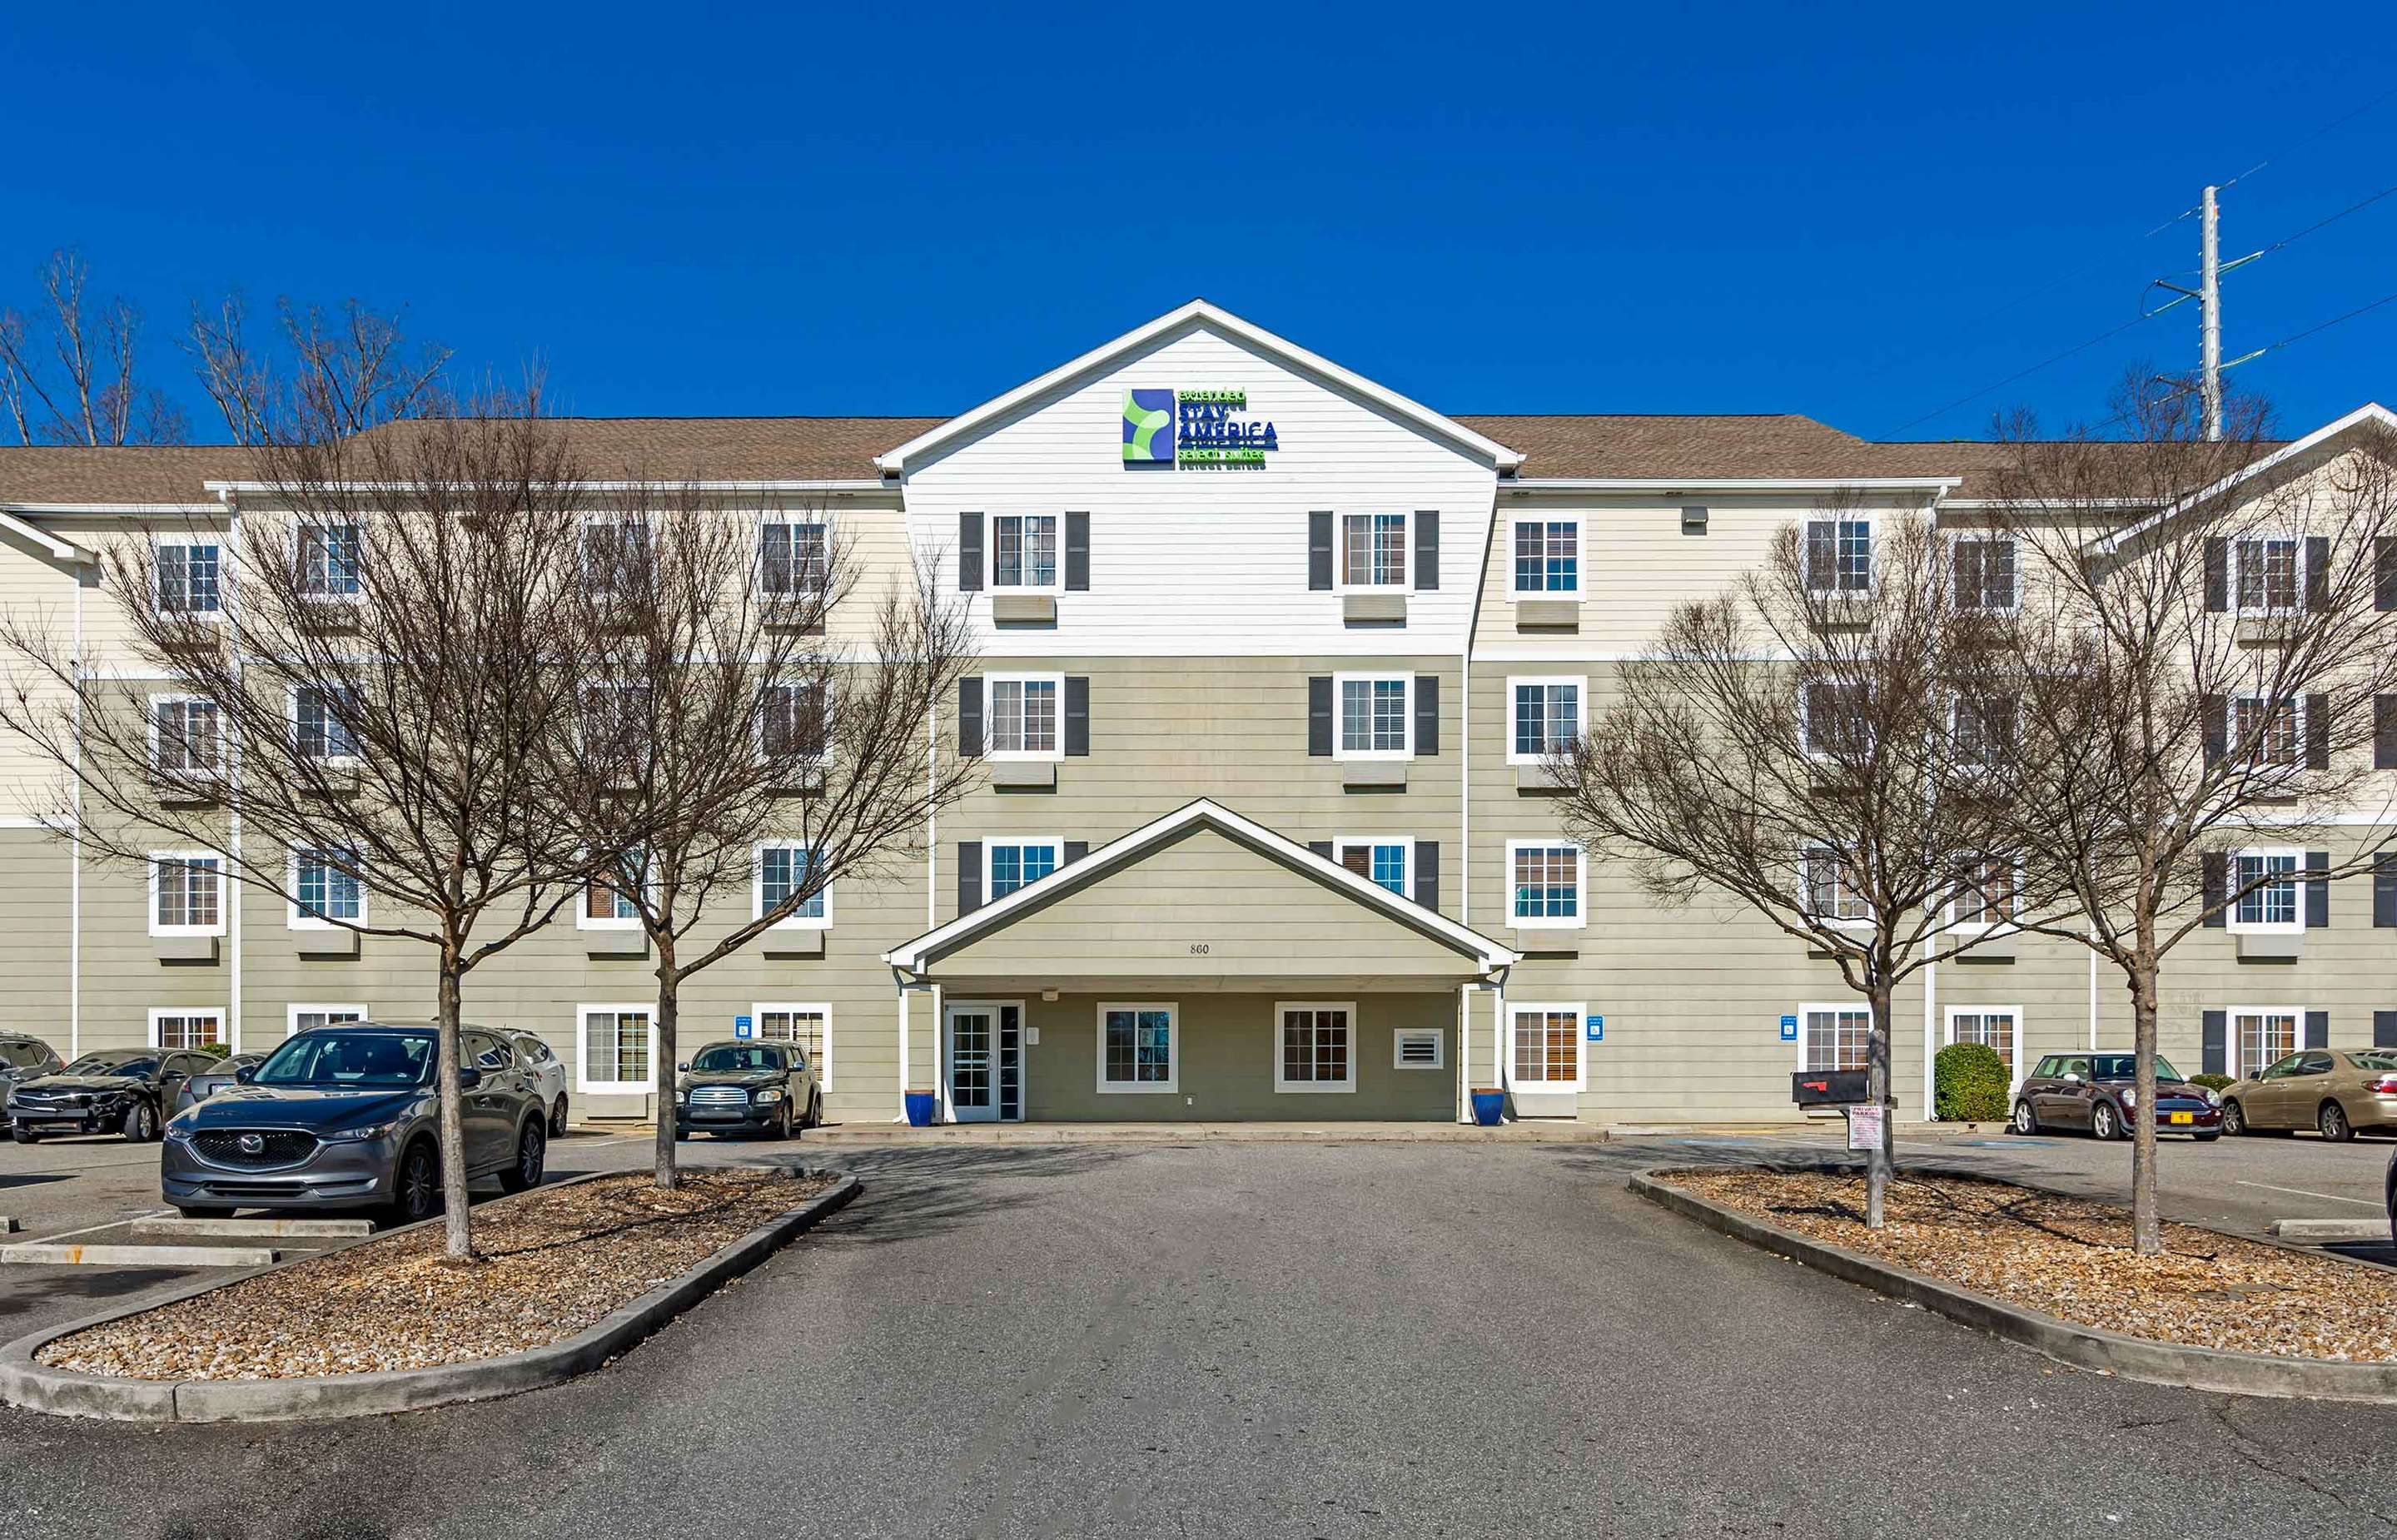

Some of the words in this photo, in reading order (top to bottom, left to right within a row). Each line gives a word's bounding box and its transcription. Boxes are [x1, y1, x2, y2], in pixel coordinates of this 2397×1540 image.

[1178, 388, 1246, 403] extended
[1179, 403, 1228, 423] STAY
[1178, 421, 1277, 443] AMERICA
[1178, 446, 1221, 462] select
[1225, 447, 1266, 462] suites
[1191, 944, 1209, 954] 860
